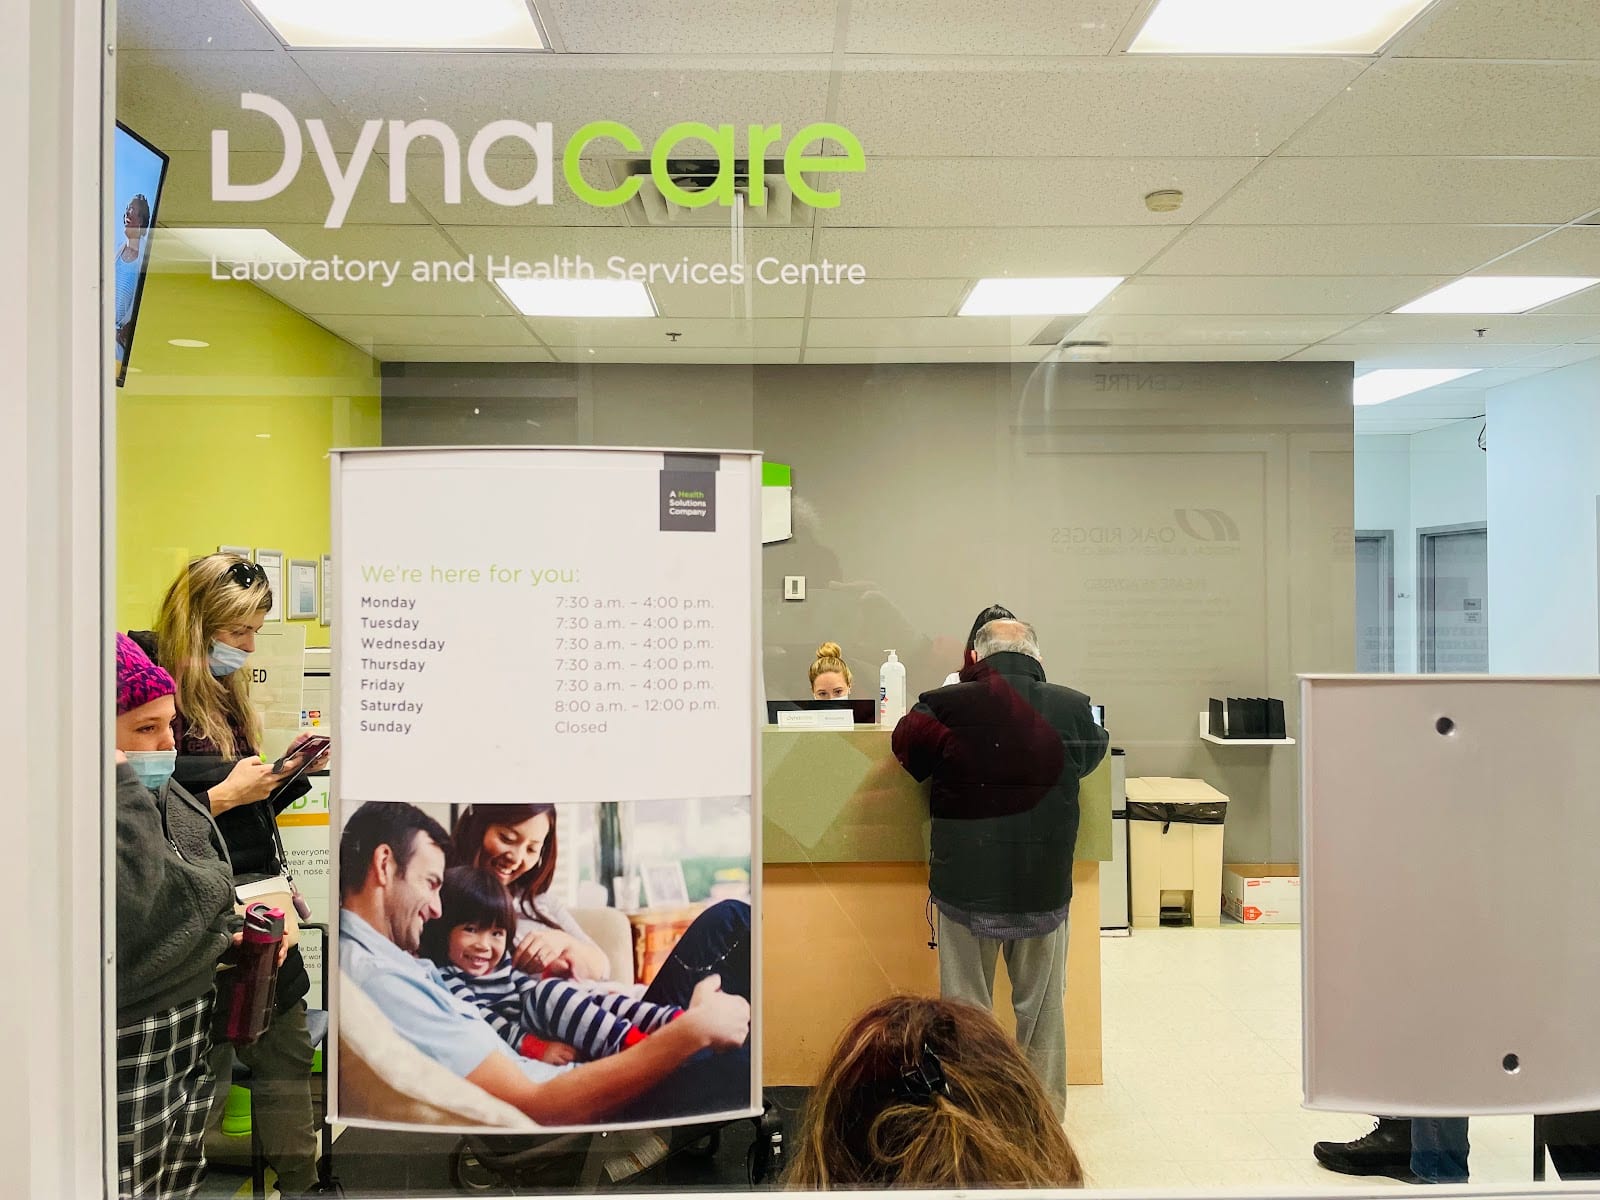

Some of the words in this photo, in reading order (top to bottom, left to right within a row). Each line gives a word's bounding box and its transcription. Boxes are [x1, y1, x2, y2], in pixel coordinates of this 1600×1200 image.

[211, 93, 866, 228] Dynacare
[211, 255, 399, 287] Laboratory
[411, 255, 474, 282] and
[487, 255, 595, 281] Health
[606, 257, 744, 284] Services
[756, 257, 866, 285] Centre
[669, 490, 677, 498] A
[678, 490, 705, 499] Health
[669, 499, 707, 507] Solutions
[669, 508, 707, 517] Company
[361, 565, 423, 583] We're
[431, 565, 481, 583] here
[489, 564, 523, 583] for
[531, 567, 581, 587] you:
[361, 596, 416, 610] Monday
[556, 596, 589, 609] 7:30
[593, 599, 625, 609] a.m.
[642, 596, 679, 608] 4:00
[683, 599, 714, 610] p.m.
[361, 617, 420, 631] Tuesday
[556, 617, 589, 630] 7:30
[593, 620, 625, 630] a.m.
[642, 617, 679, 629] 4:00
[683, 620, 714, 631] p.m.
[361, 638, 446, 652] Wednesday
[556, 638, 589, 650] 7:30
[593, 641, 625, 650] a.m.
[642, 637, 679, 649] 4:00
[683, 640, 714, 651] p.m.
[361, 658, 426, 673] Thursday
[556, 658, 589, 671] 7:30
[593, 661, 625, 671] a.m.
[642, 657, 679, 670] 4:00
[683, 660, 714, 672] p.m.
[360, 679, 405, 693] Friday
[556, 679, 589, 691] 7:30
[593, 682, 625, 691] a.m.
[642, 678, 679, 690] 4:00
[683, 681, 714, 692] p.m.
[360, 700, 424, 714] Saturday
[555, 700, 591, 712] 8:00
[595, 702, 627, 712] a.m.
[644, 699, 685, 711] 12:00
[689, 700, 720, 712] p.m.
[360, 720, 412, 735] Sunday
[555, 721, 608, 734] Closed
